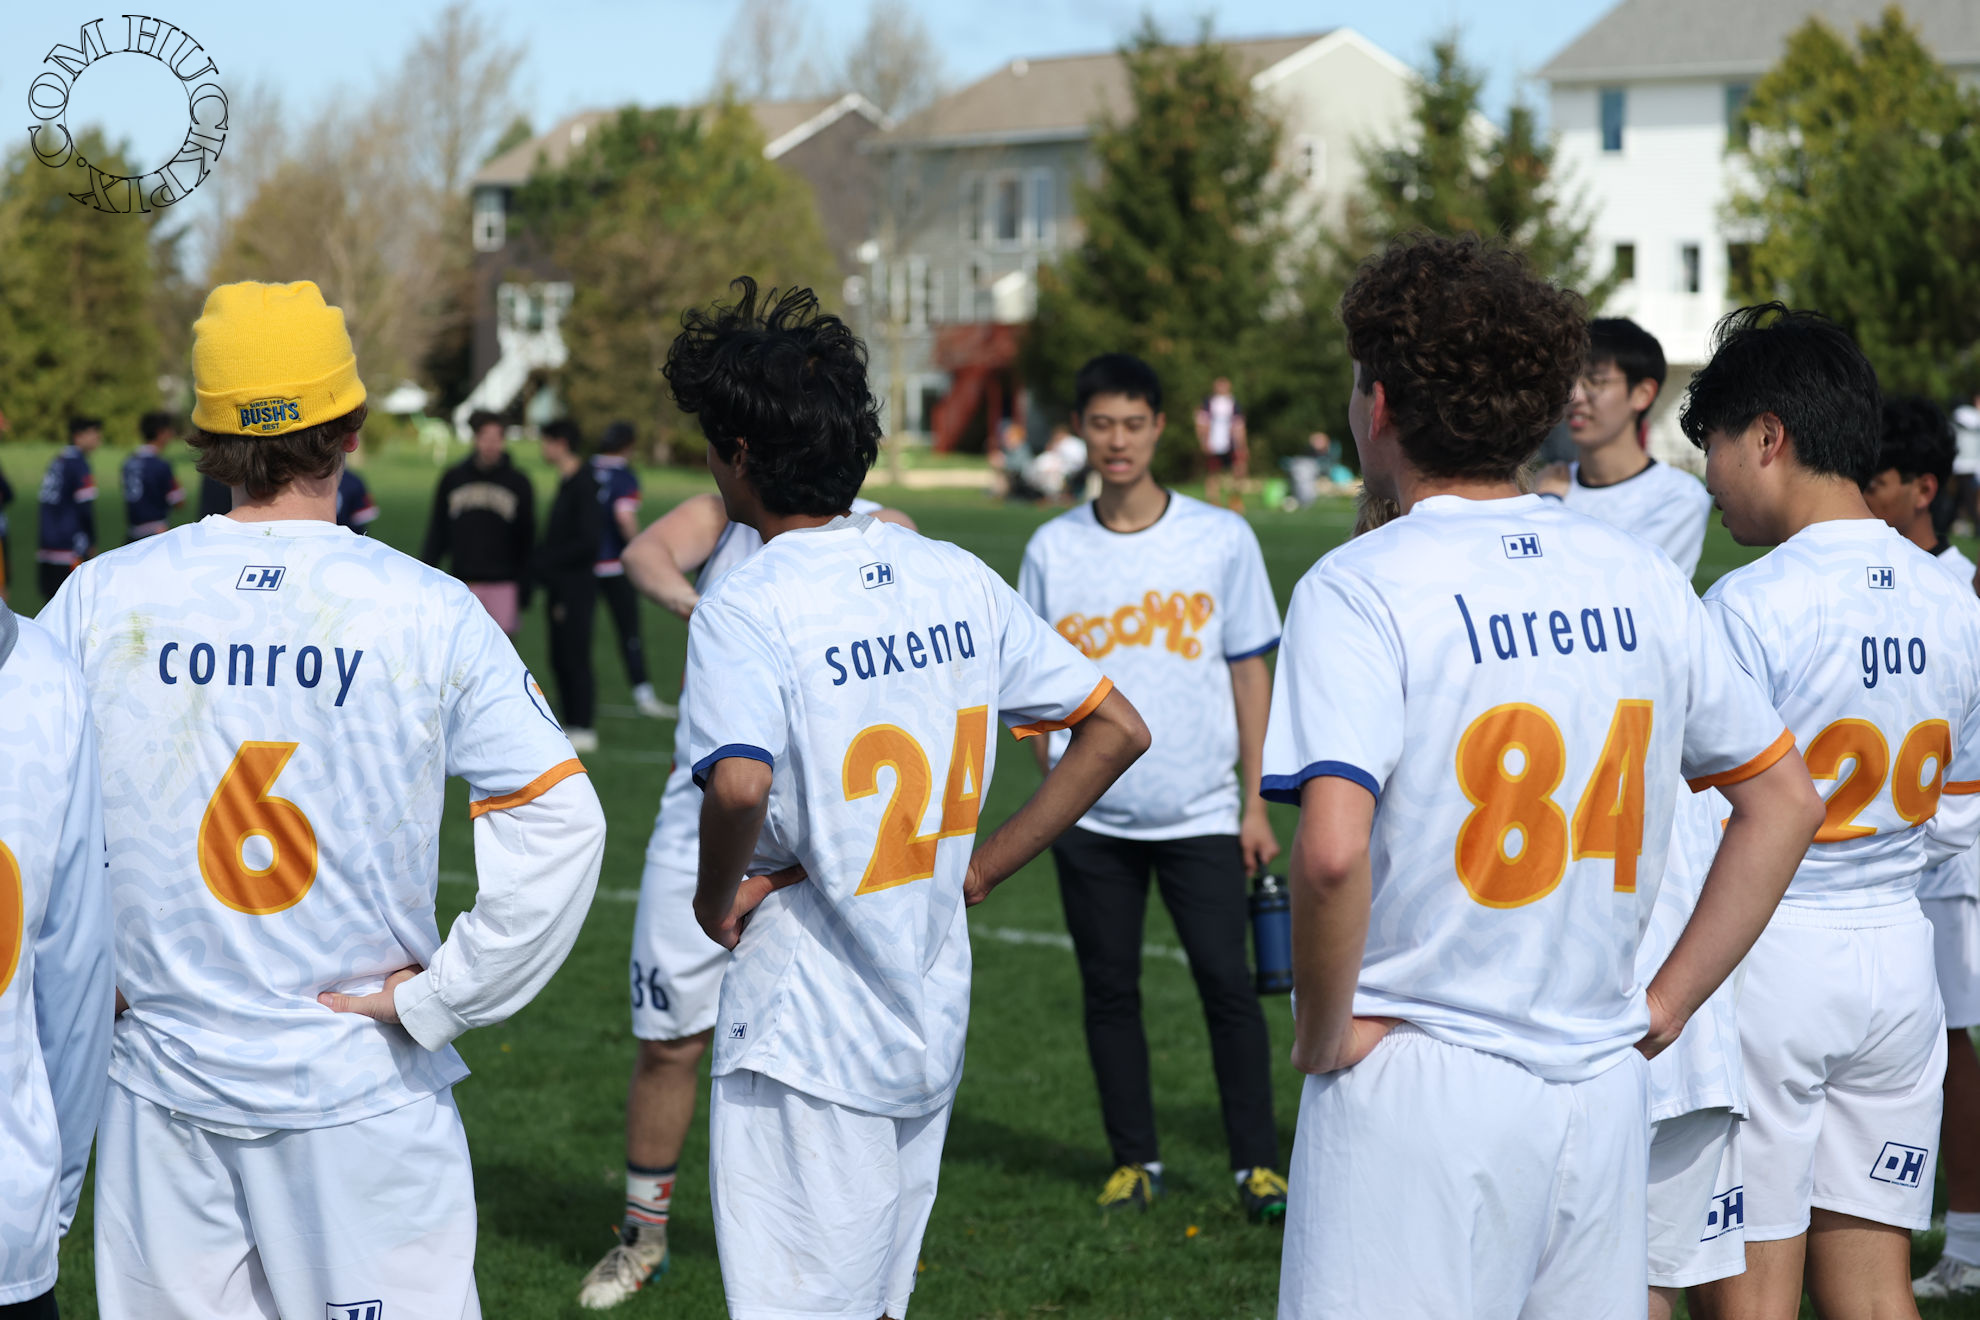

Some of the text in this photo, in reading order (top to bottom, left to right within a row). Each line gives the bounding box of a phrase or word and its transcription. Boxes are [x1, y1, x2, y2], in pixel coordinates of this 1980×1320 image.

[240, 402, 299, 427] BUSH'S
[825, 620, 977, 686] saxena
[1055, 590, 1214, 661] BOOM!
[1454, 594, 1638, 664] lareau
[158, 642, 364, 707] conroy
[1861, 635, 1927, 689] gao
[841, 704, 989, 897] 24
[1455, 698, 1654, 909] 84
[1803, 717, 1952, 843] 29
[197, 740, 318, 915] 6
[631, 961, 669, 1011] 36
